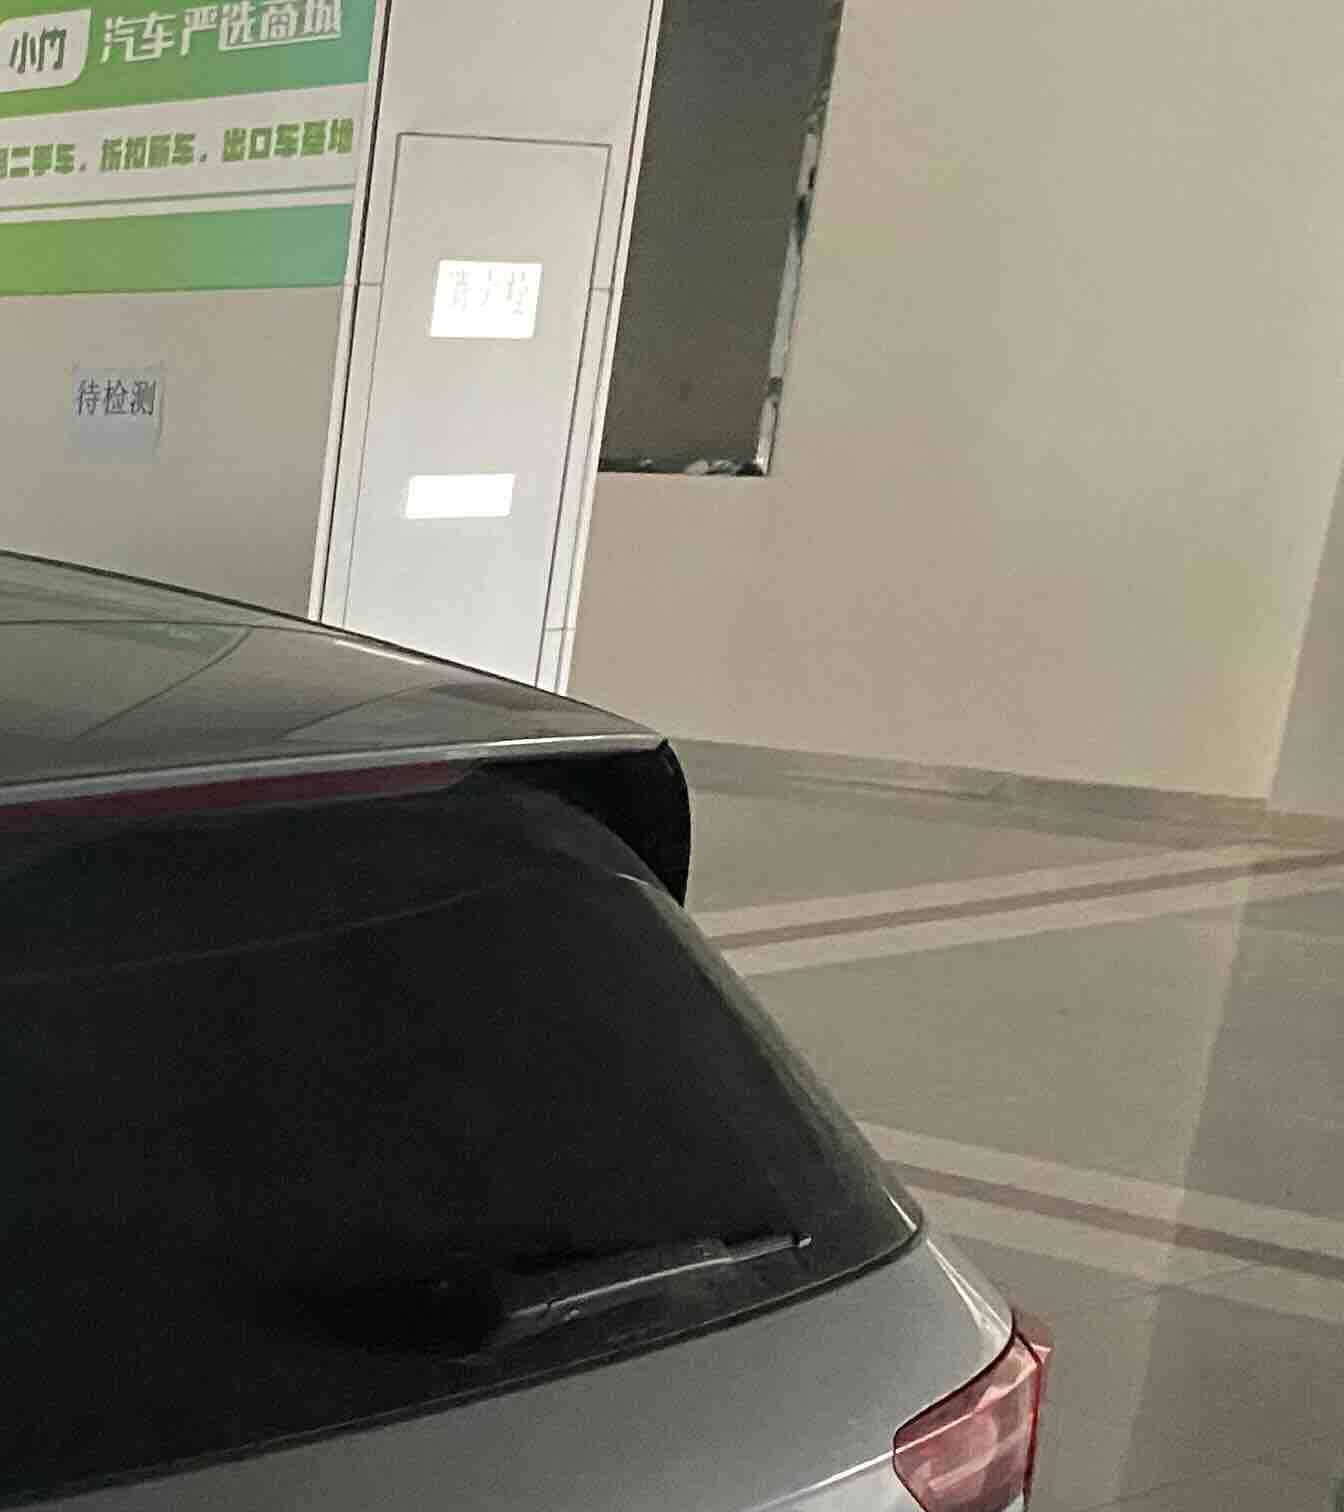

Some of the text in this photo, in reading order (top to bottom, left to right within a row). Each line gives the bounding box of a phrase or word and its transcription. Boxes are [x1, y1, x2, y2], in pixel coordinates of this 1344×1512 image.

[100, 0, 343, 64] 汽车严选商城
[75, 378, 157, 417] 待检测
